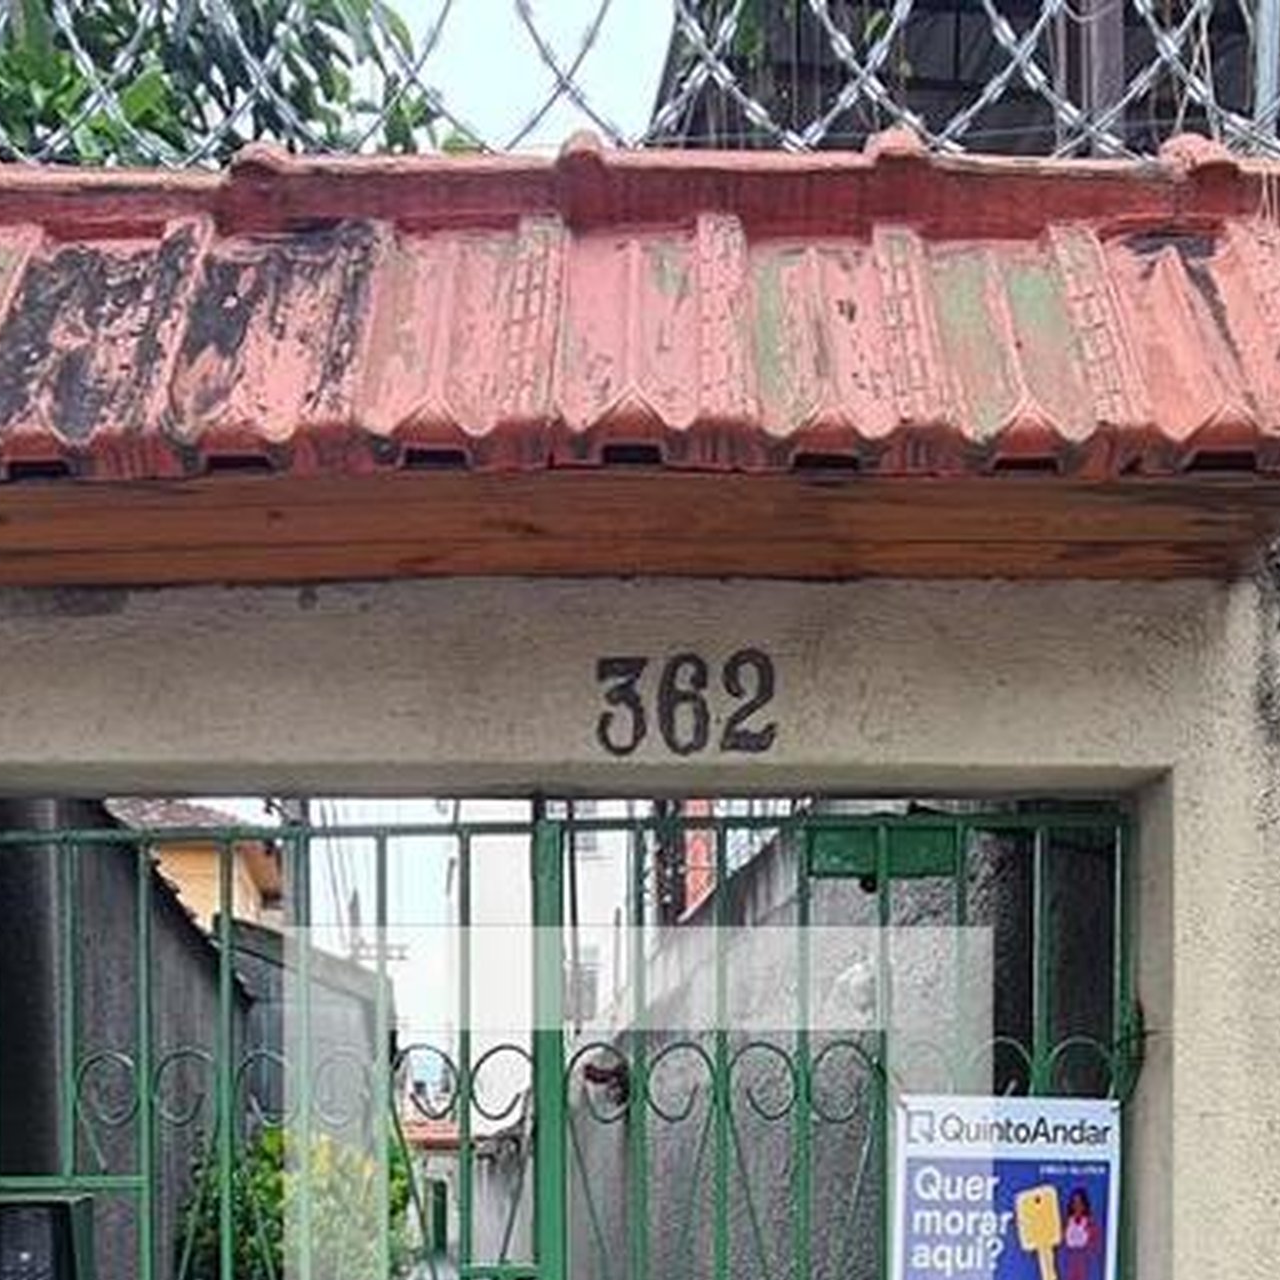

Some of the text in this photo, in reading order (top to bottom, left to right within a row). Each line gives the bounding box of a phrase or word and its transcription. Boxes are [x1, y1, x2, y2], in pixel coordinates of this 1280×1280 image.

[596, 649, 778, 756] 362
[939, 1113, 1112, 1145] QuintoAndar
[914, 1165, 999, 1201] Quer
[912, 1208, 1013, 1236] morar
[910, 1237, 1004, 1277] aqui?
